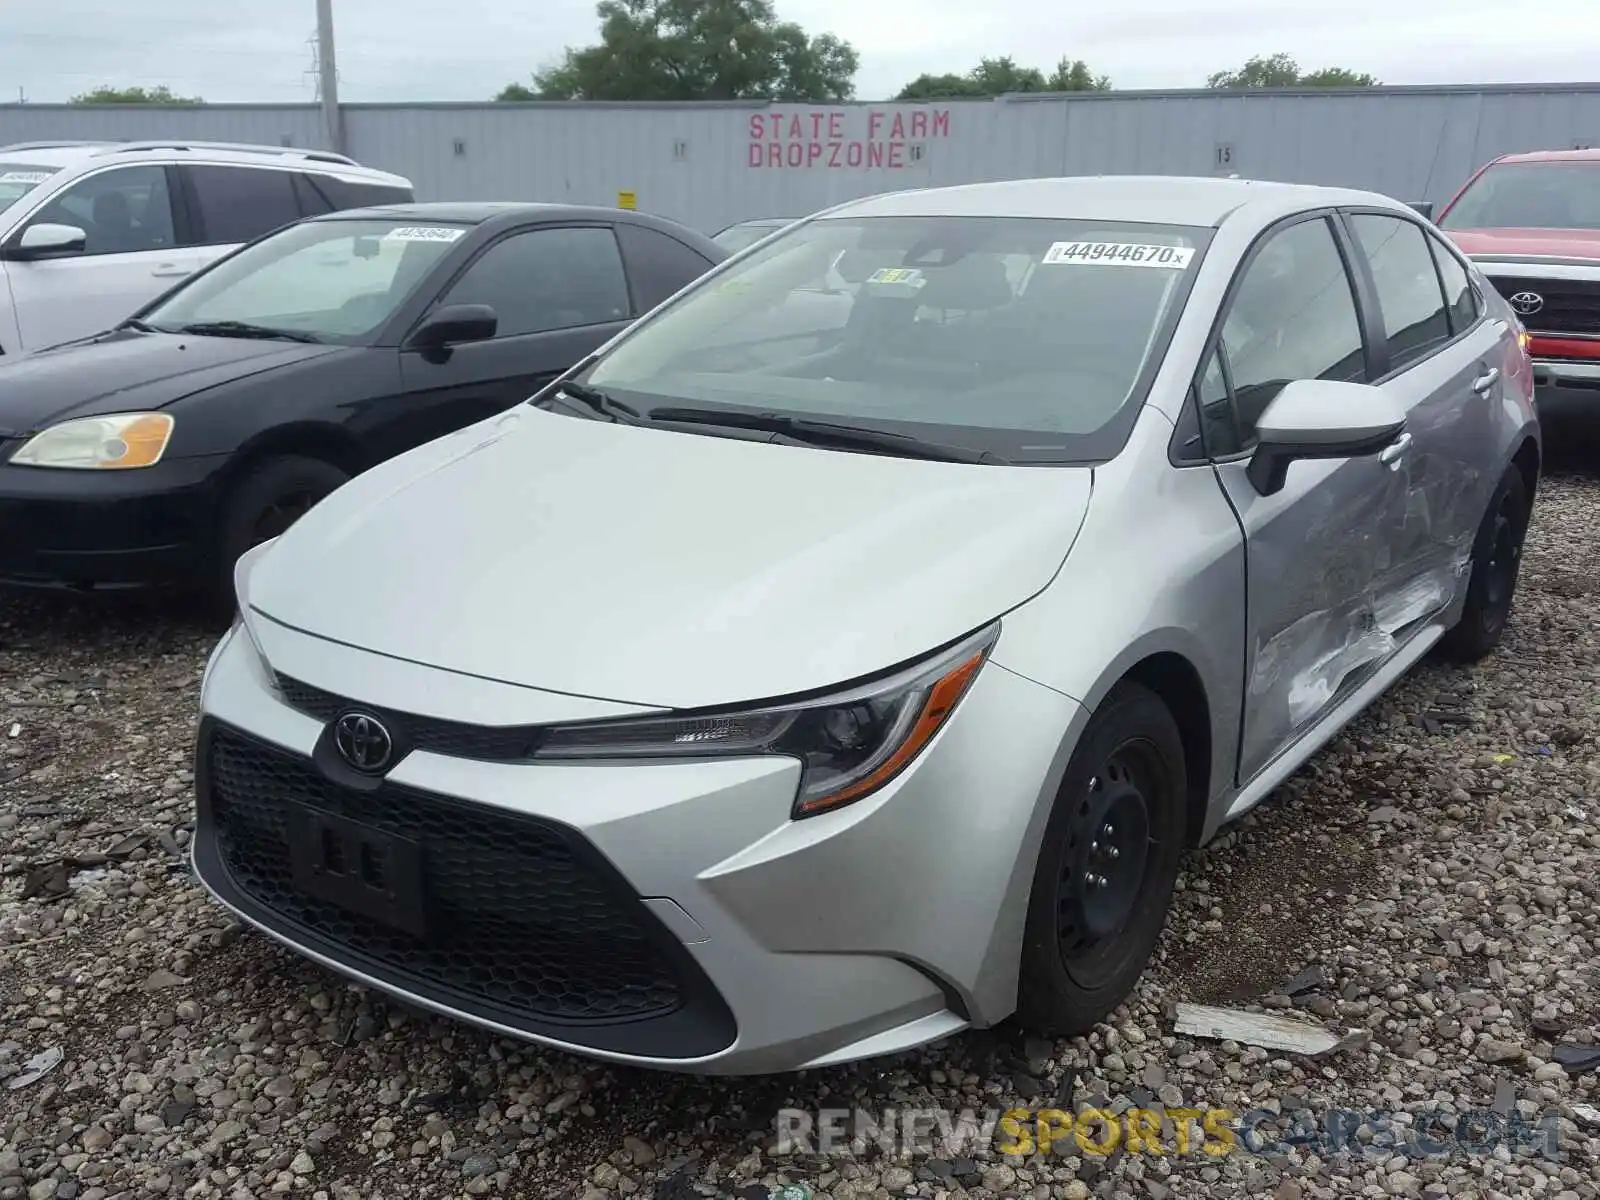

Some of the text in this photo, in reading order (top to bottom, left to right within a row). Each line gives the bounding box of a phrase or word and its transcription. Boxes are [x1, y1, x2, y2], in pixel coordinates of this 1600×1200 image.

[750, 110, 950, 139] STATE FARM
[748, 142, 905, 168] DROPZONE
[1217, 147, 1231, 164] 15
